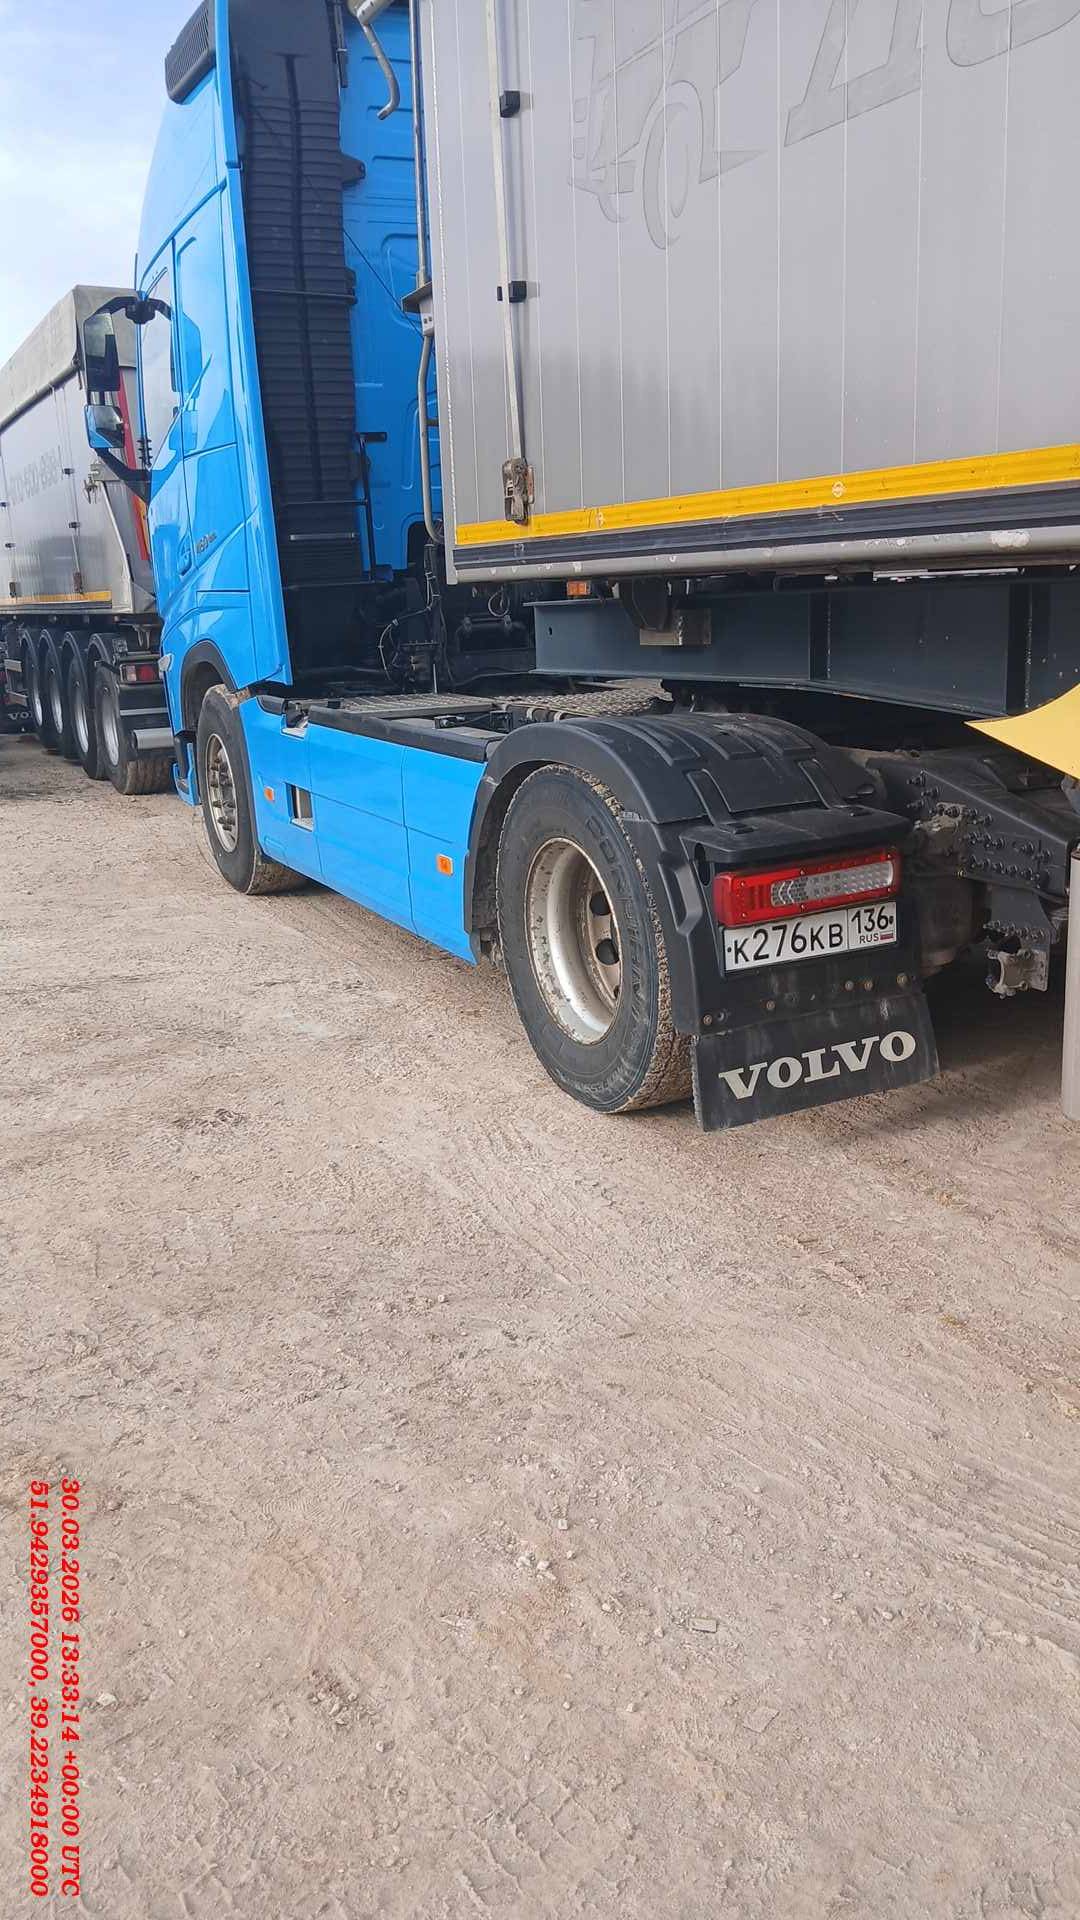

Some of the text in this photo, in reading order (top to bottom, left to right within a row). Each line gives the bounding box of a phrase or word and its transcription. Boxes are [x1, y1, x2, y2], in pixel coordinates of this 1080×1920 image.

[850, 905, 889, 935] 136
[859, 933, 880, 945] RUS
[718, 1030, 916, 1100] VOLVO
